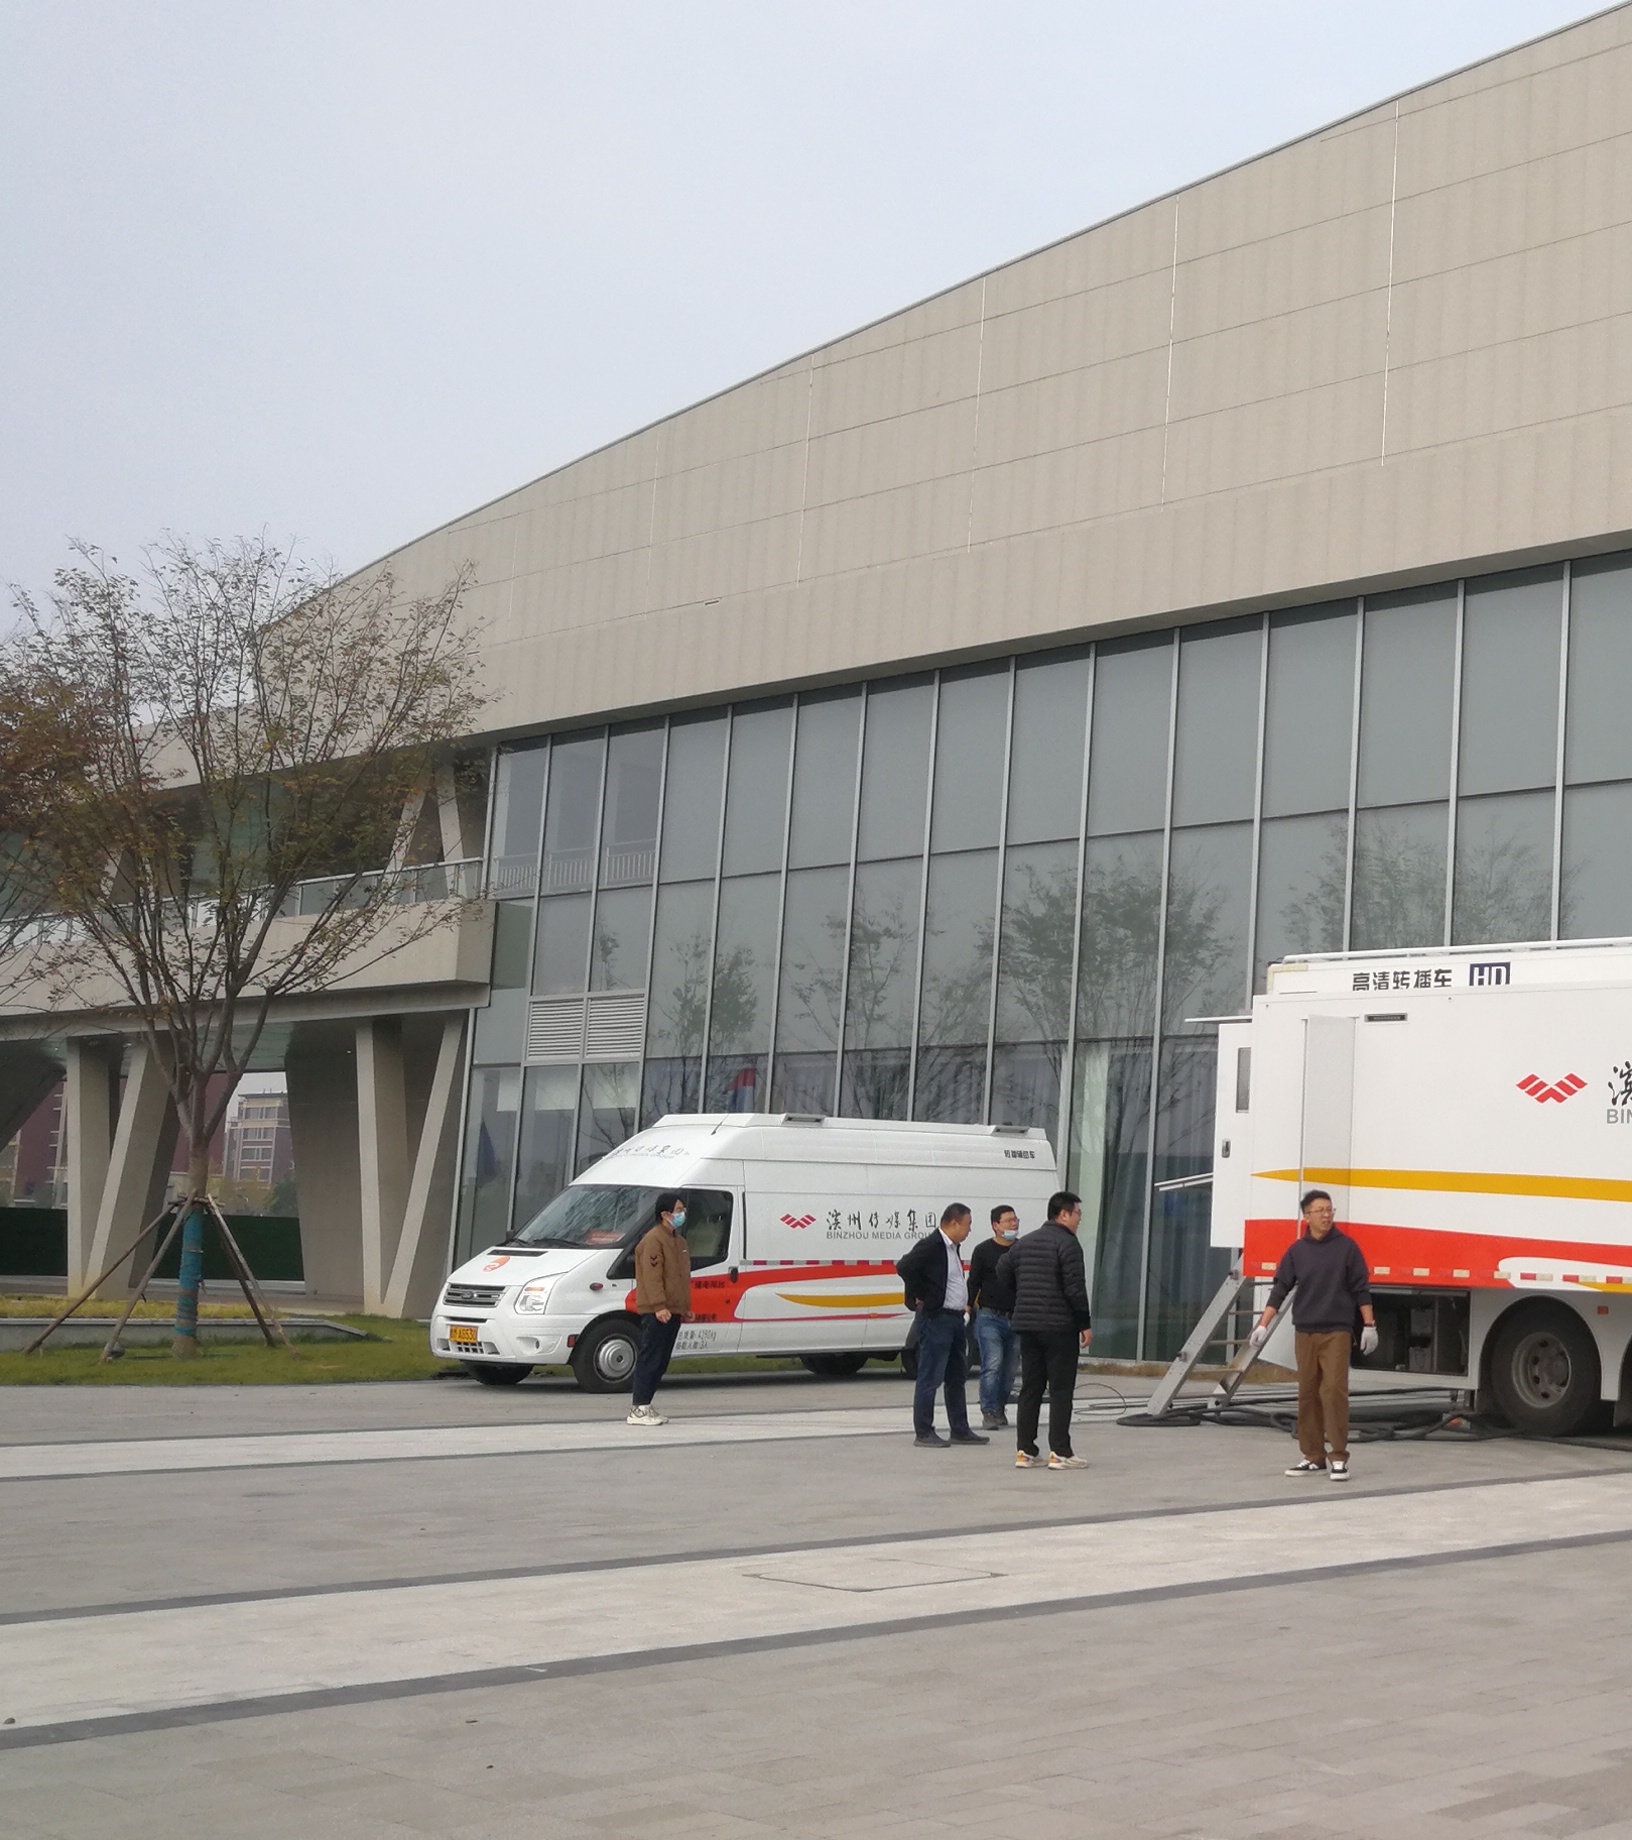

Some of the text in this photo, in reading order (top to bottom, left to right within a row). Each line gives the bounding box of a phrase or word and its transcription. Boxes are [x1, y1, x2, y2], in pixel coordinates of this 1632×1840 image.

[1352, 969, 1452, 991] 高清转播车
[826, 1208, 937, 1232] 滨州传媒集团
[826, 1231, 869, 1240] BINZHOU
[875, 1231, 901, 1240] MEDIA
